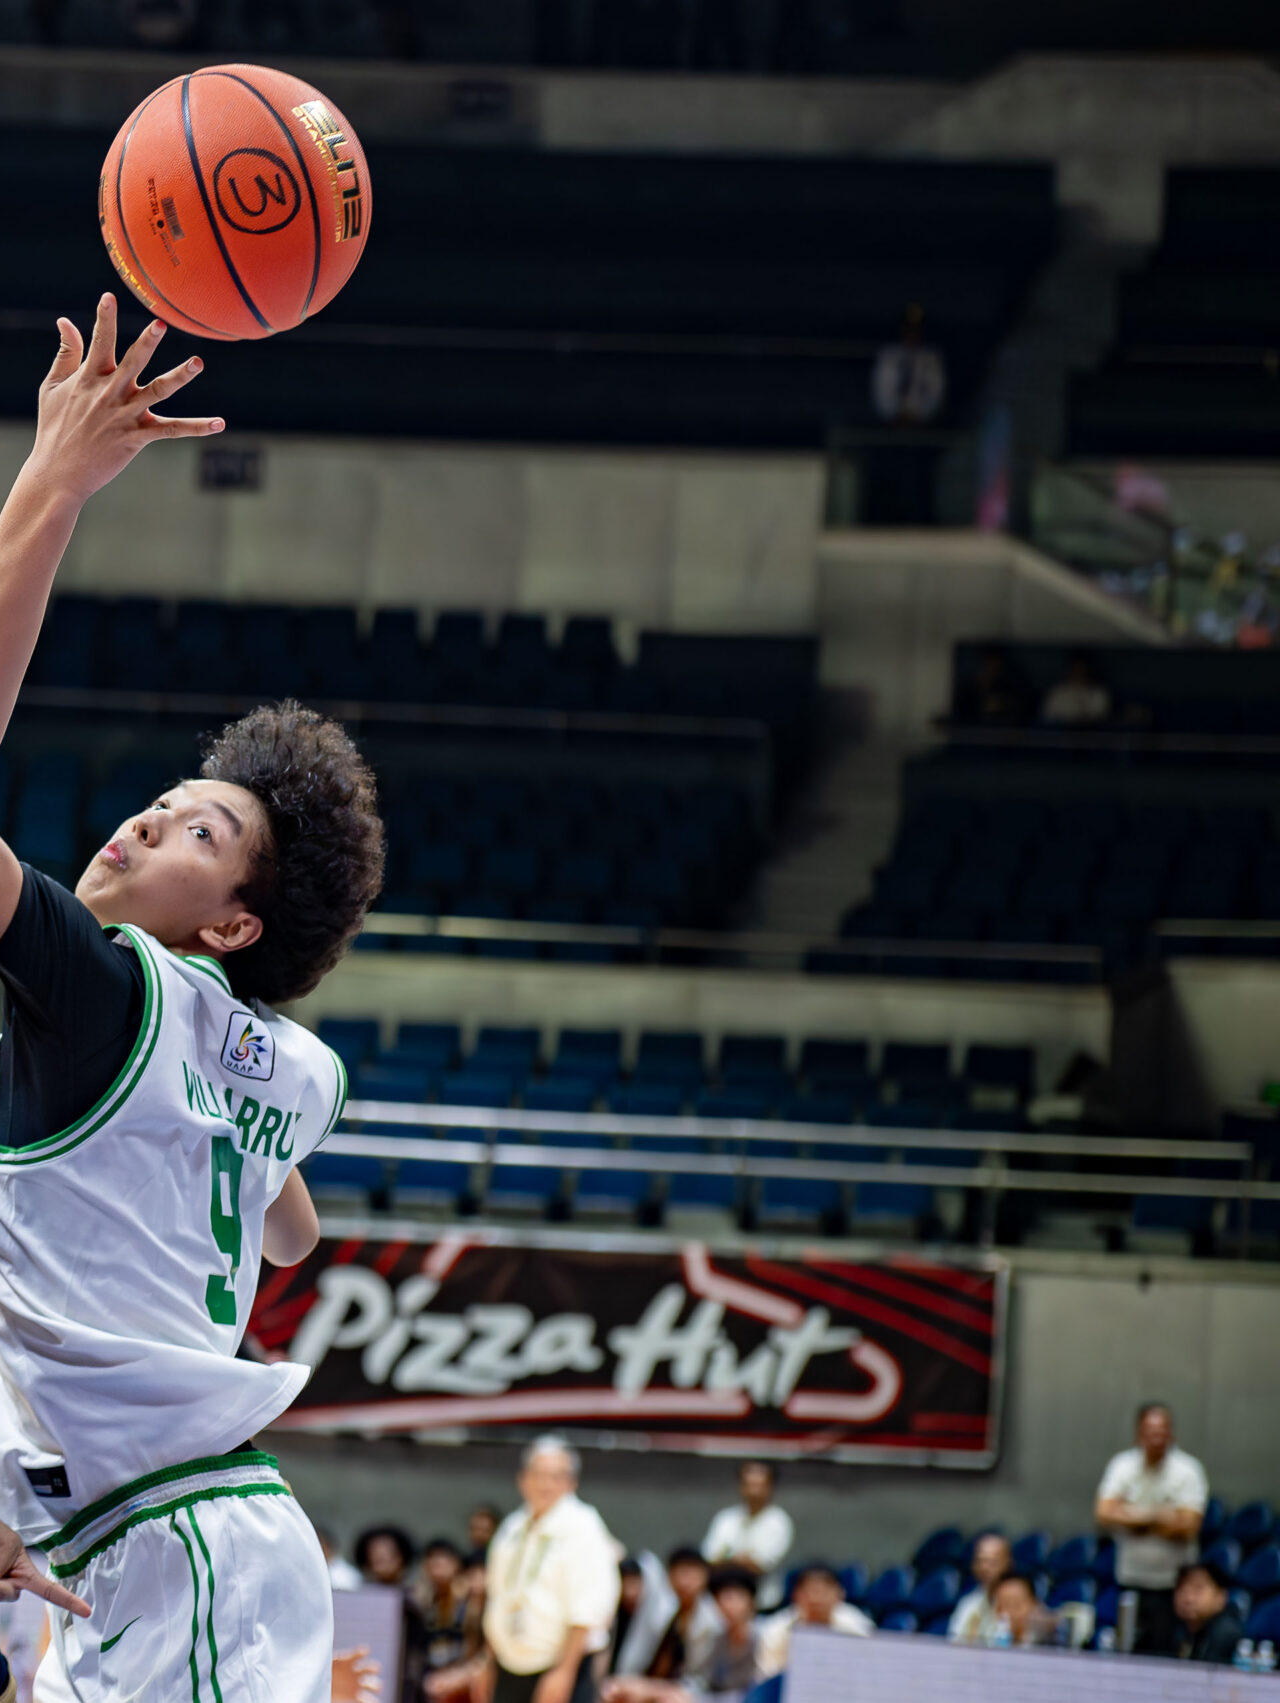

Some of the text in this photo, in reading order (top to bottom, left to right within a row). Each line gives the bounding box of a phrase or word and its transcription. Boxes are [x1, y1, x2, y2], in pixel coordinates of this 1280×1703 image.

[227, 171, 287, 217] 3
[300, 99, 362, 241] ELITE
[226, 1060, 254, 1073] UAAP
[205, 1135, 244, 1326] 9
[289, 1262, 862, 1406] Pizza Hut
